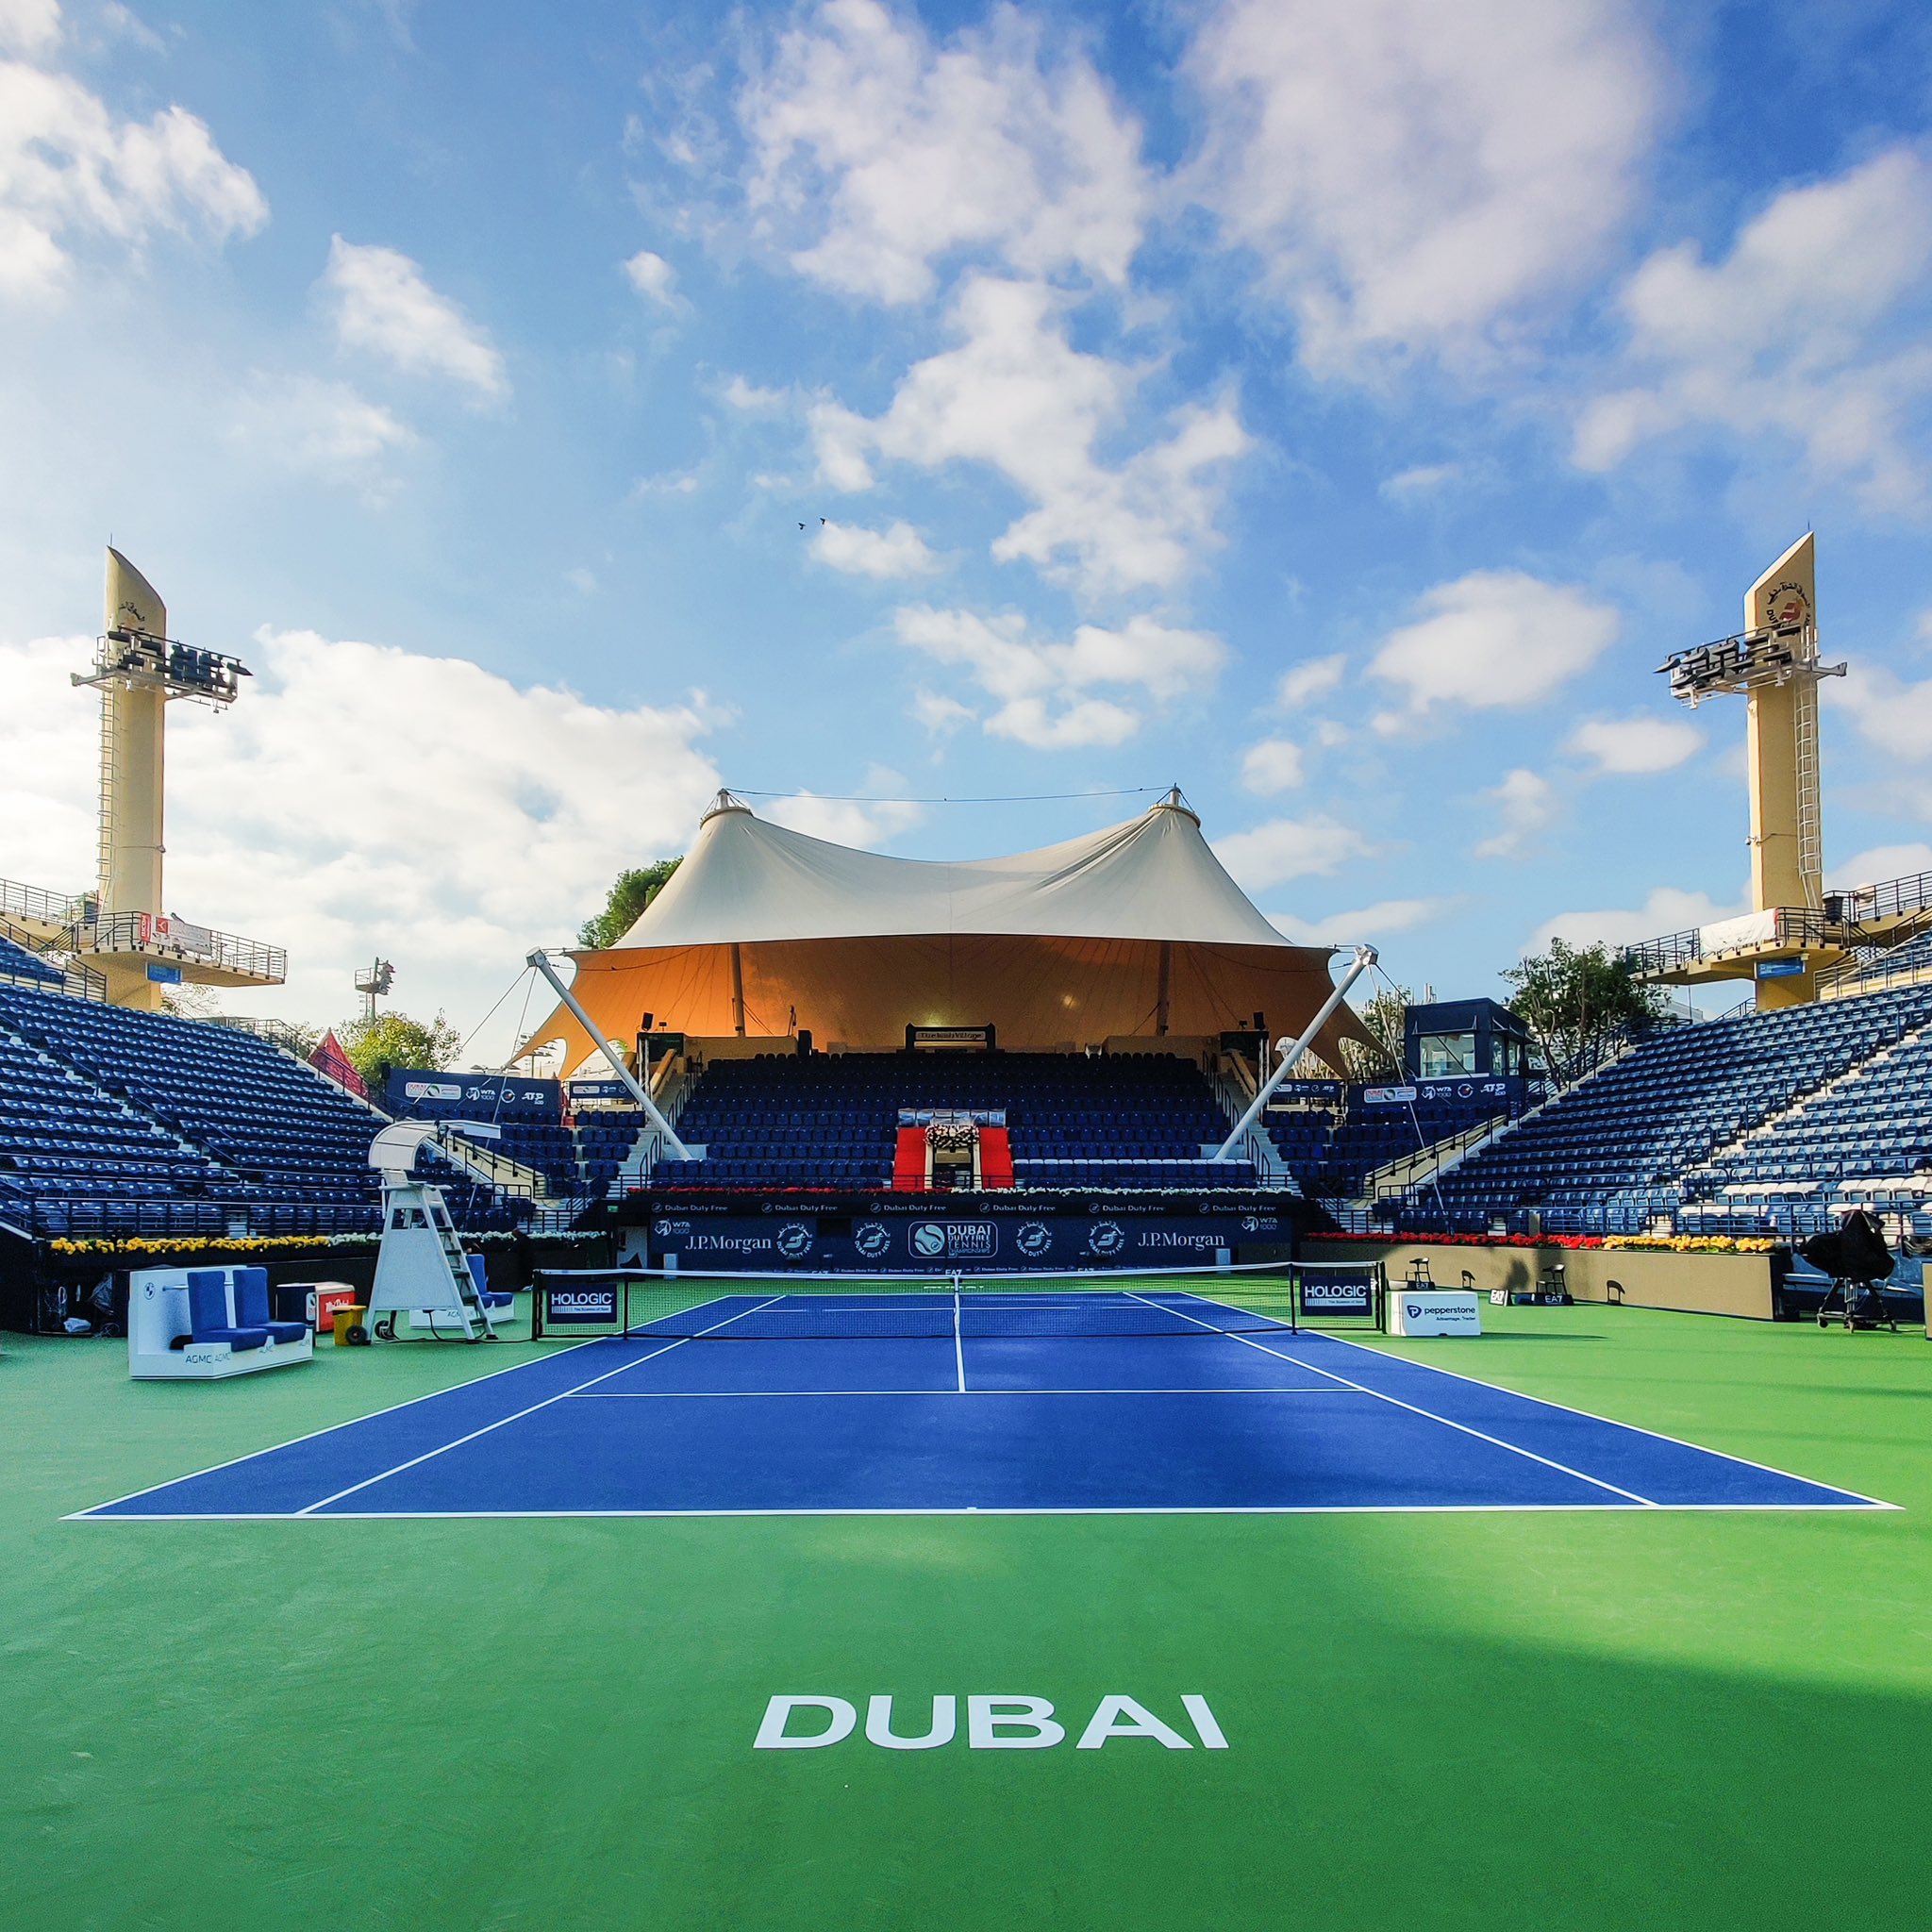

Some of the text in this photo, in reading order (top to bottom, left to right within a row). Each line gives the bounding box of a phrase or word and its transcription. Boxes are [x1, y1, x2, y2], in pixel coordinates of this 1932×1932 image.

[1480, 1084, 1506, 1093] ATP
[522, 1091, 544, 1102] ATP
[947, 1225, 991, 1236] DUBAI
[948, 1241, 991, 1249] TENNIS
[1305, 1285, 1366, 1297] HOLOGIC
[1491, 1290, 1505, 1301] EA7
[551, 1292, 612, 1305] HOLOGIC
[1424, 1307, 1475, 1315] pepperstone
[185, 1355, 212, 1364] AGMC
[753, 1694, 1230, 1749] DUBAI
